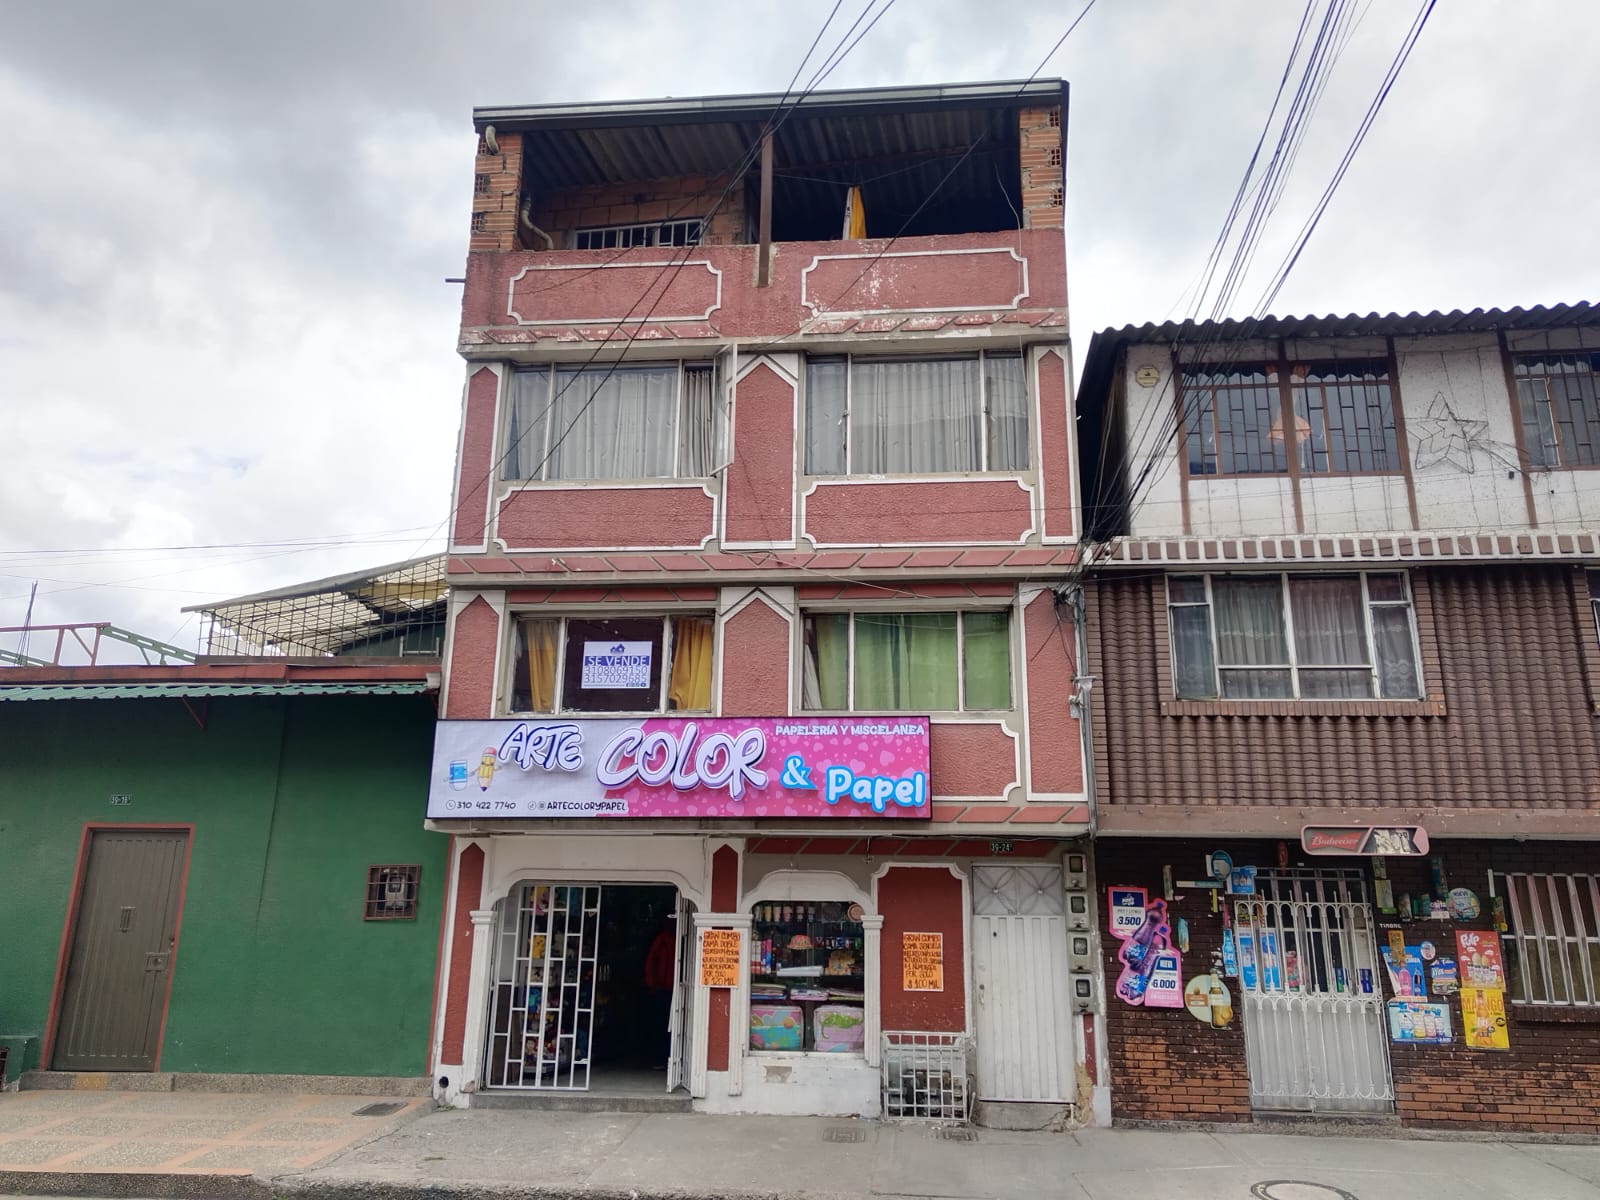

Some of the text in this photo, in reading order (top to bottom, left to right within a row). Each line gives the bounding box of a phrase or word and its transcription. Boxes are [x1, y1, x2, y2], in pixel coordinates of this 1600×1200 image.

[588, 655, 647, 666] SE VENDE
[584, 666, 648, 675] 3108069150
[775, 724, 925, 736] PAPELERIA Y MISCELANEA
[498, 723, 583, 771] ARTE
[596, 722, 769, 801] COLOR
[780, 755, 816, 790] &
[826, 765, 926, 813] Papel
[456, 801, 516, 809] 310 422 7740
[547, 801, 627, 811] ARTECOLORYPAPEL
